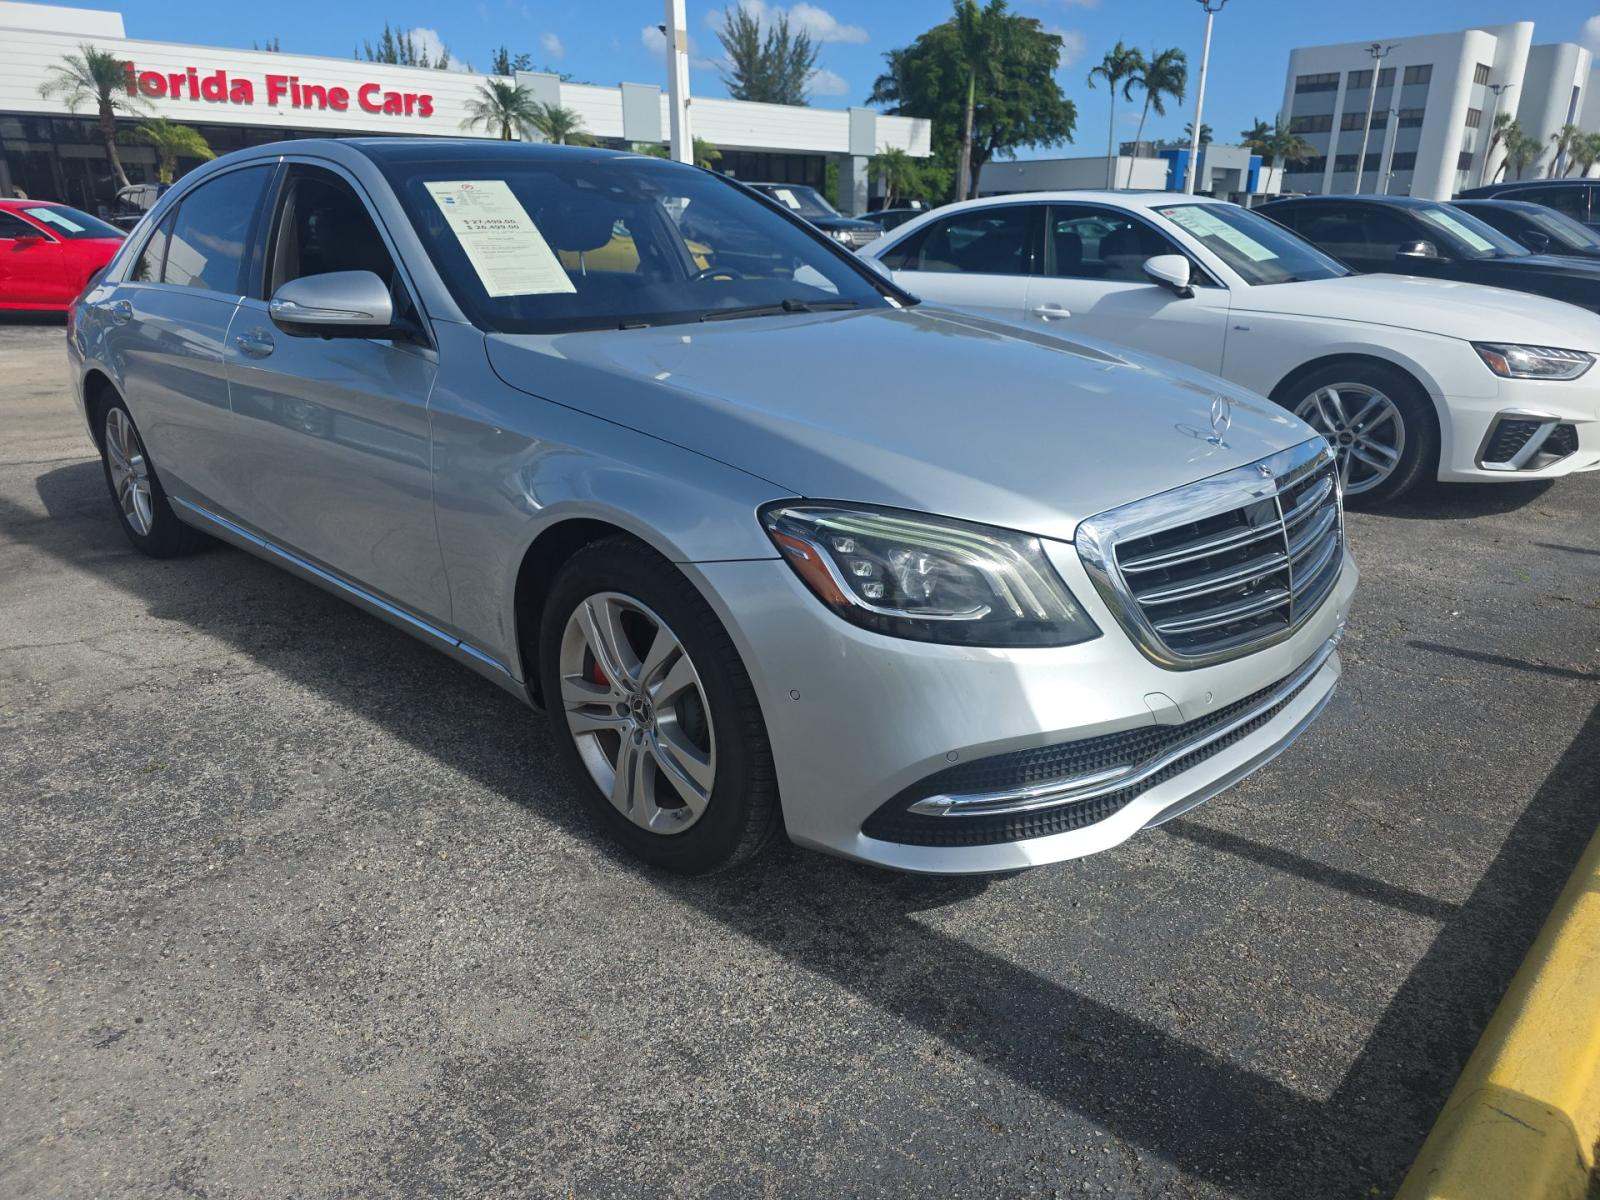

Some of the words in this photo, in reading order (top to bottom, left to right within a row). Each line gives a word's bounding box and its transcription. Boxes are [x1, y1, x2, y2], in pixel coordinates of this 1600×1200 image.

[114, 60, 253, 105] lorida
[265, 74, 349, 113] Fine
[357, 82, 434, 118] Cars
